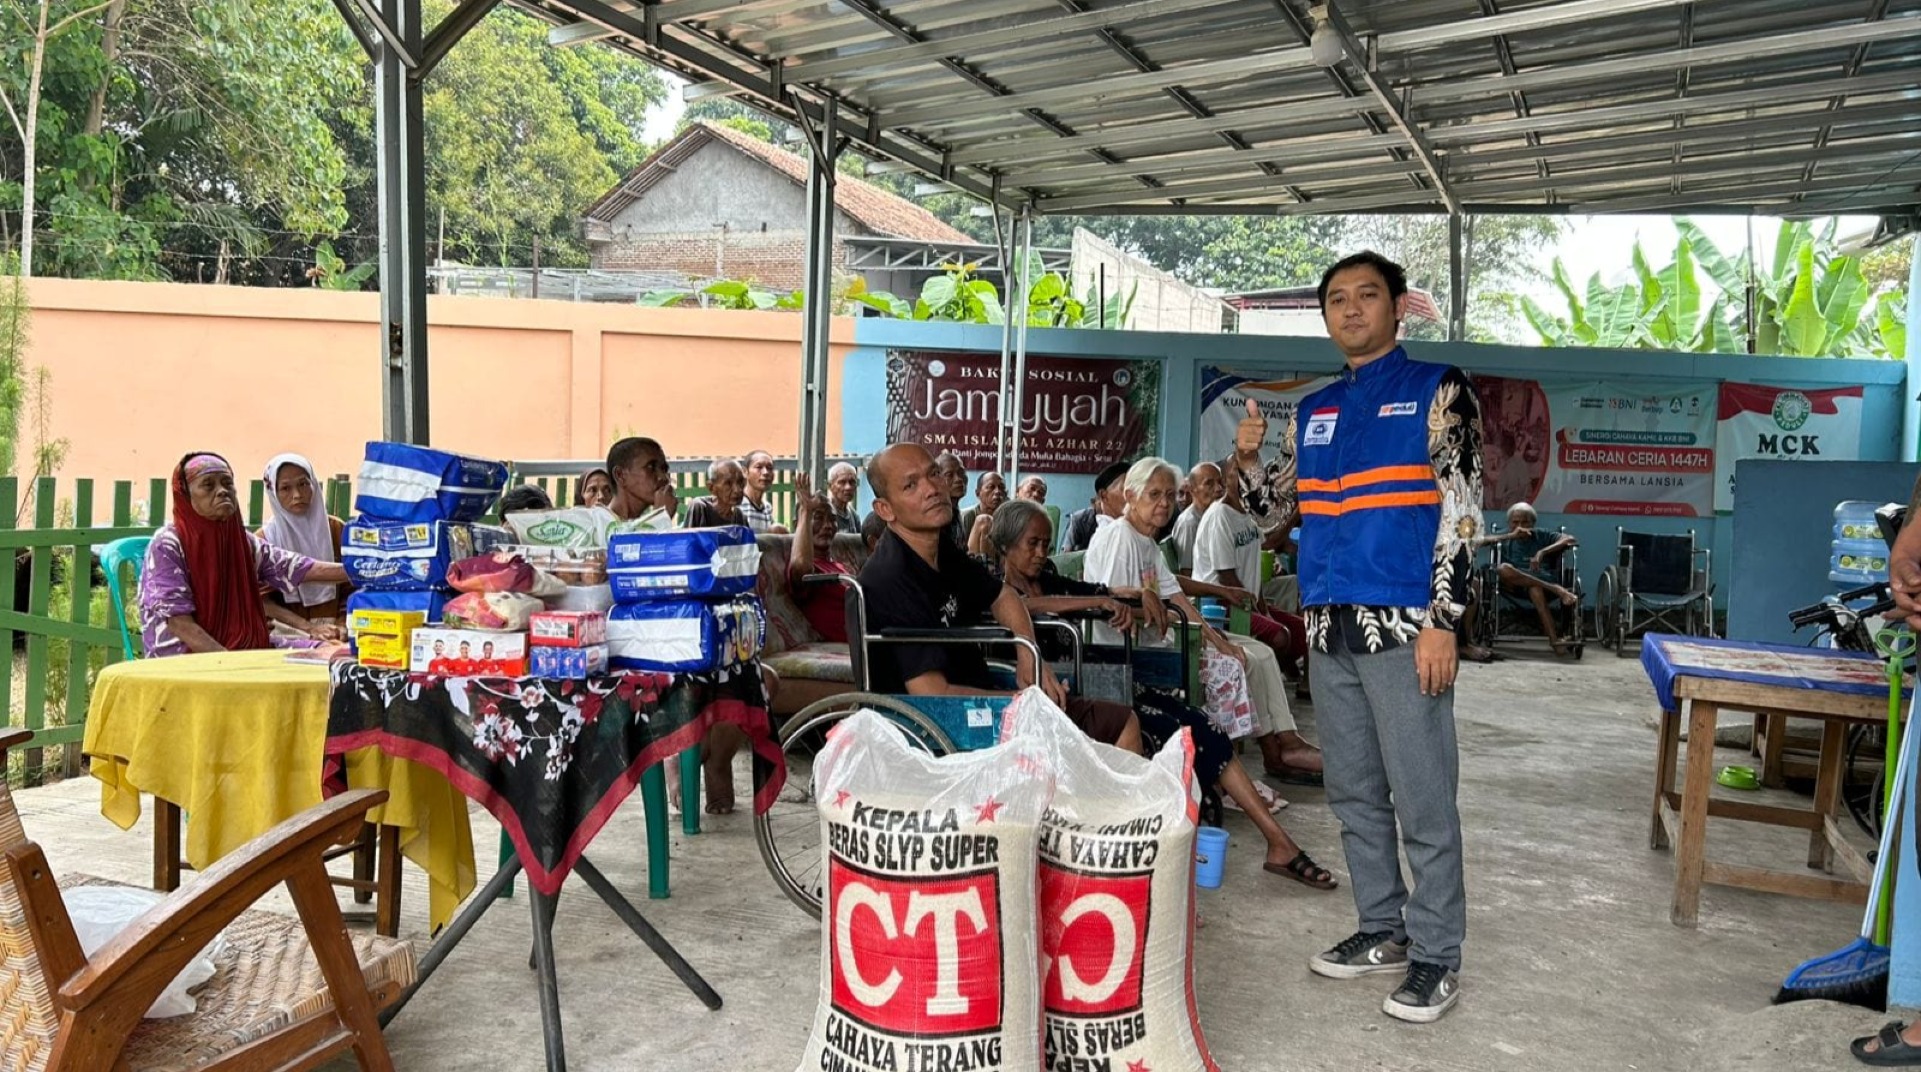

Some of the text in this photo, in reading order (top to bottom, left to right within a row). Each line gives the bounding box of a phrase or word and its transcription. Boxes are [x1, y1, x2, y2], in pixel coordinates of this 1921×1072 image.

[1028, 369, 1099, 383] SOSIAL
[924, 433, 957, 445] SMA
[1019, 437, 1038, 448] AL
[1046, 439, 1099, 450] AZHAR
[1565, 449, 1707, 467] LEBARAN CERIA 1447H
[1757, 433, 1820, 455] MCK
[1580, 473, 1684, 487] BERSAMA LANSIA
[852, 801, 959, 833] KEPALA
[828, 821, 869, 864] BERAS
[874, 832, 924, 871] SLYP
[930, 834, 999, 871] SUPER
[1070, 834, 1159, 869] CAHAYA
[836, 881, 989, 1017] CT
[1043, 892, 1137, 1004] C
[826, 1013, 1002, 1072] CAHAYA TERANG
[1045, 1012, 1146, 1056] BERAS SLY
